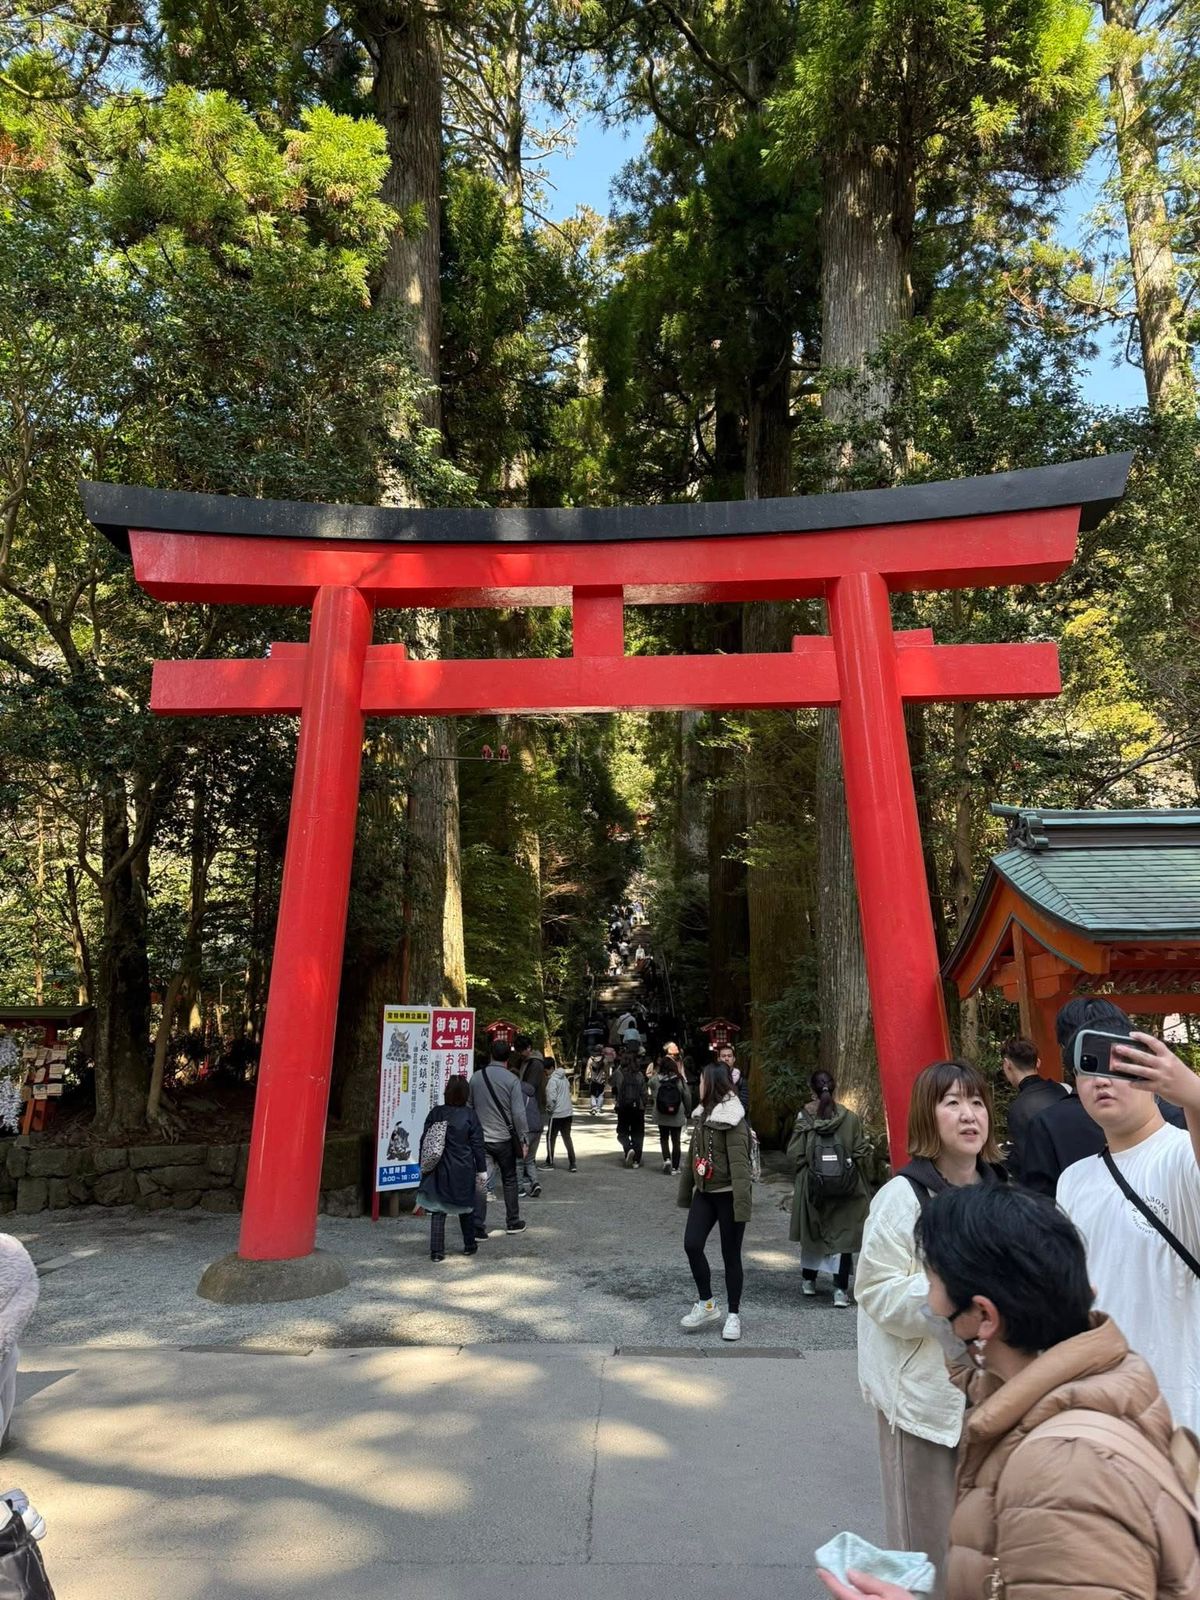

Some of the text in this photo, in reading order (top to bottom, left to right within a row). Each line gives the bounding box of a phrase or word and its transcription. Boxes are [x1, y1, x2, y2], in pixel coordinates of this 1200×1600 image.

[436, 1017, 470, 1032] 御神印
[454, 1035, 469, 1048] 受付
[419, 1027, 429, 1093] 関東総鎮守
